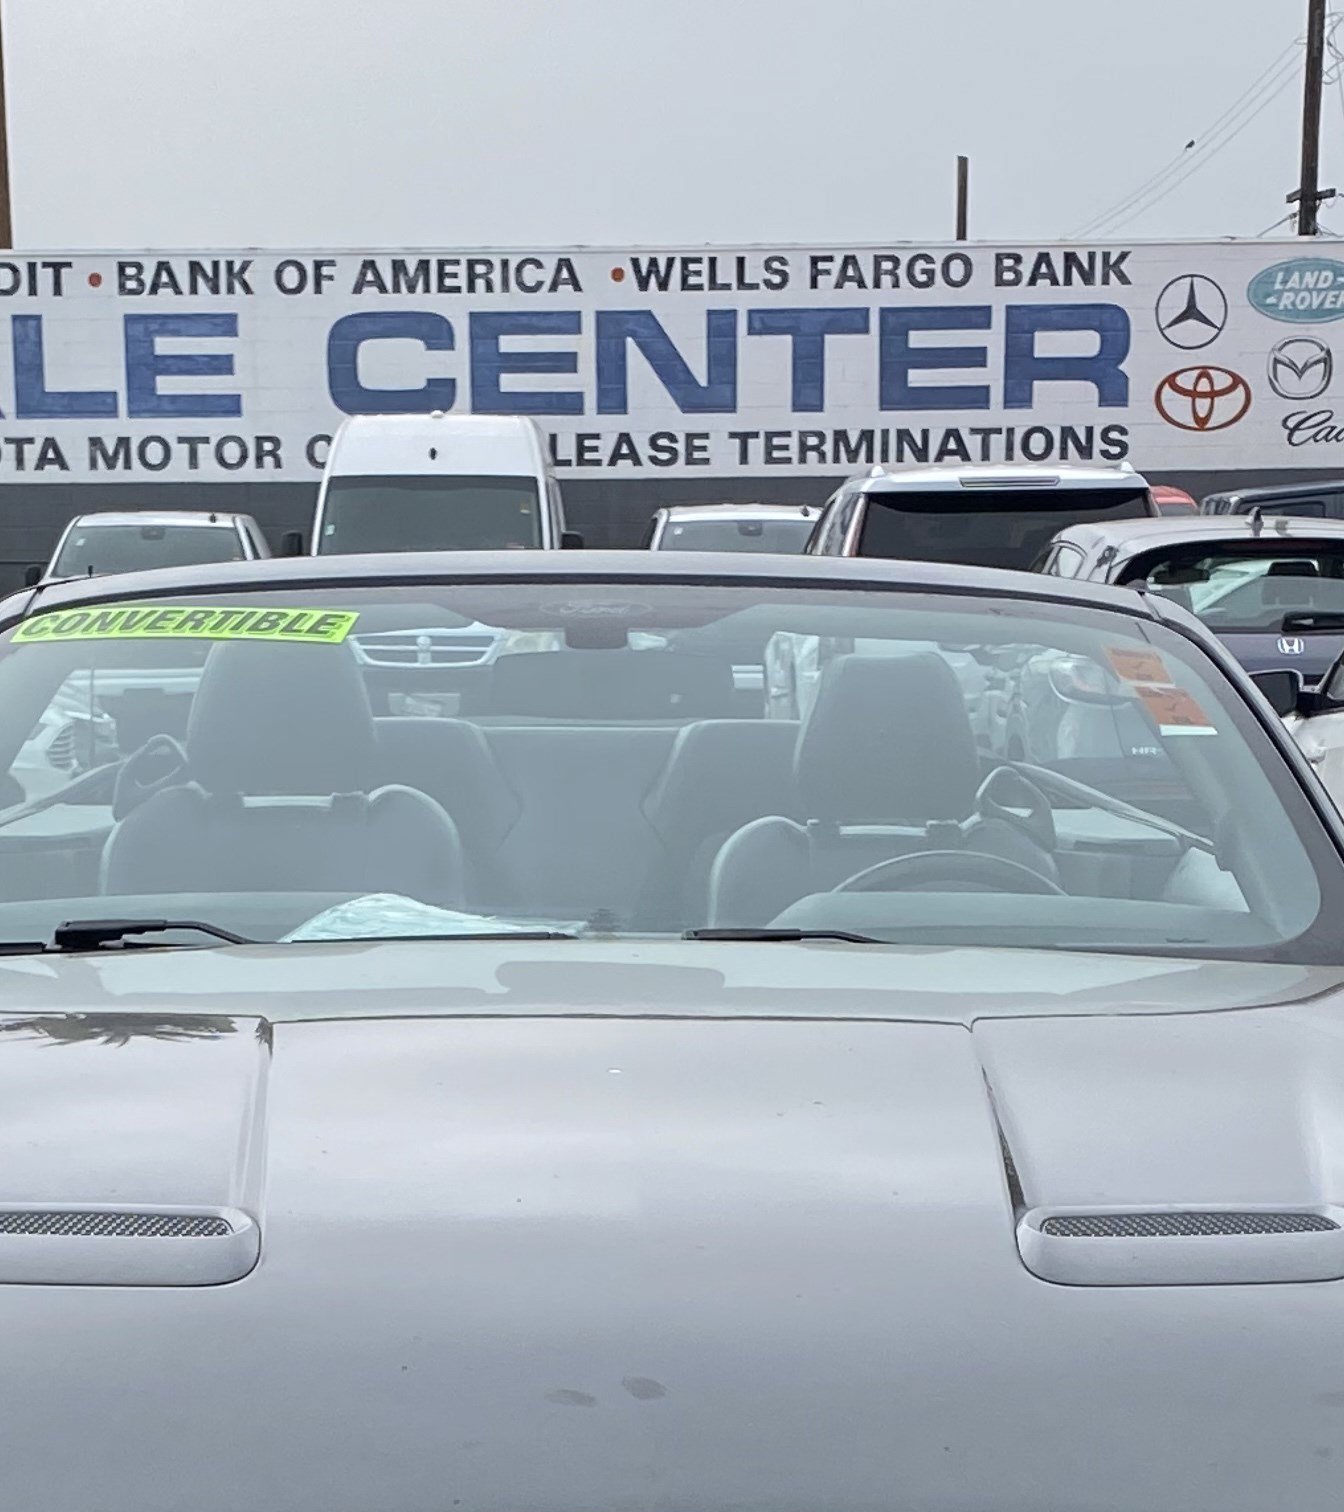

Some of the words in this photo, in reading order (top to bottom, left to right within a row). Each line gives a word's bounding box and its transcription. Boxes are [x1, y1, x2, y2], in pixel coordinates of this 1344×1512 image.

[117, 260, 255, 296] BANK
[274, 259, 337, 295] OF
[352, 257, 583, 294] AMERICA
[630, 256, 789, 292] WELLS
[809, 251, 973, 289] FARGO
[994, 250, 1132, 288] BANK
[327, 303, 1131, 415] CENTER
[88, 435, 283, 471] MOTOR
[549, 431, 710, 468] LEASE
[729, 424, 1129, 465] TERMINATIONS
[21, 609, 349, 637] CONVERTIBLE
